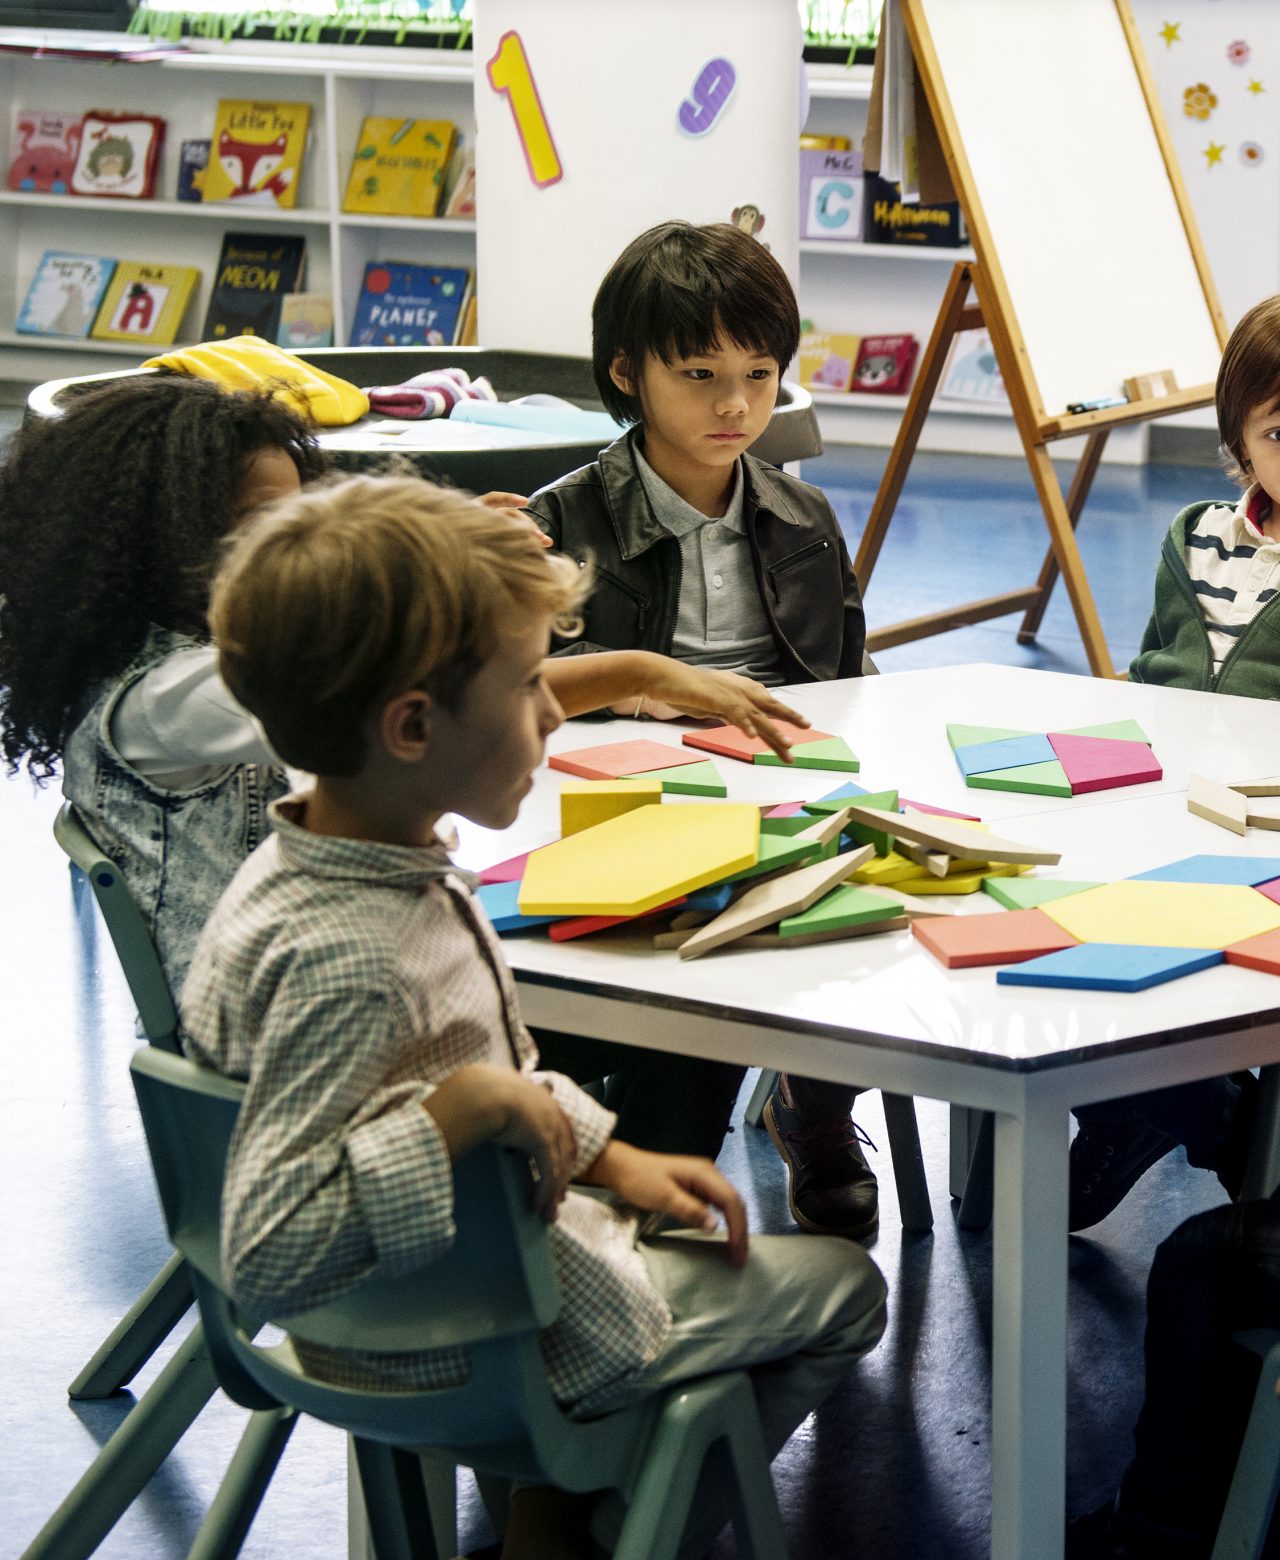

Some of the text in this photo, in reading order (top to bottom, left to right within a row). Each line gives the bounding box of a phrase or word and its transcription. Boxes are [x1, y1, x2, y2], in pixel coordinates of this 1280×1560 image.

[486, 30, 563, 189] 1
[677, 56, 737, 138] 9
[229, 111, 267, 129] Little
[816, 181, 854, 229] C
[119, 290, 154, 332] A
[370, 305, 438, 328] PLANET
